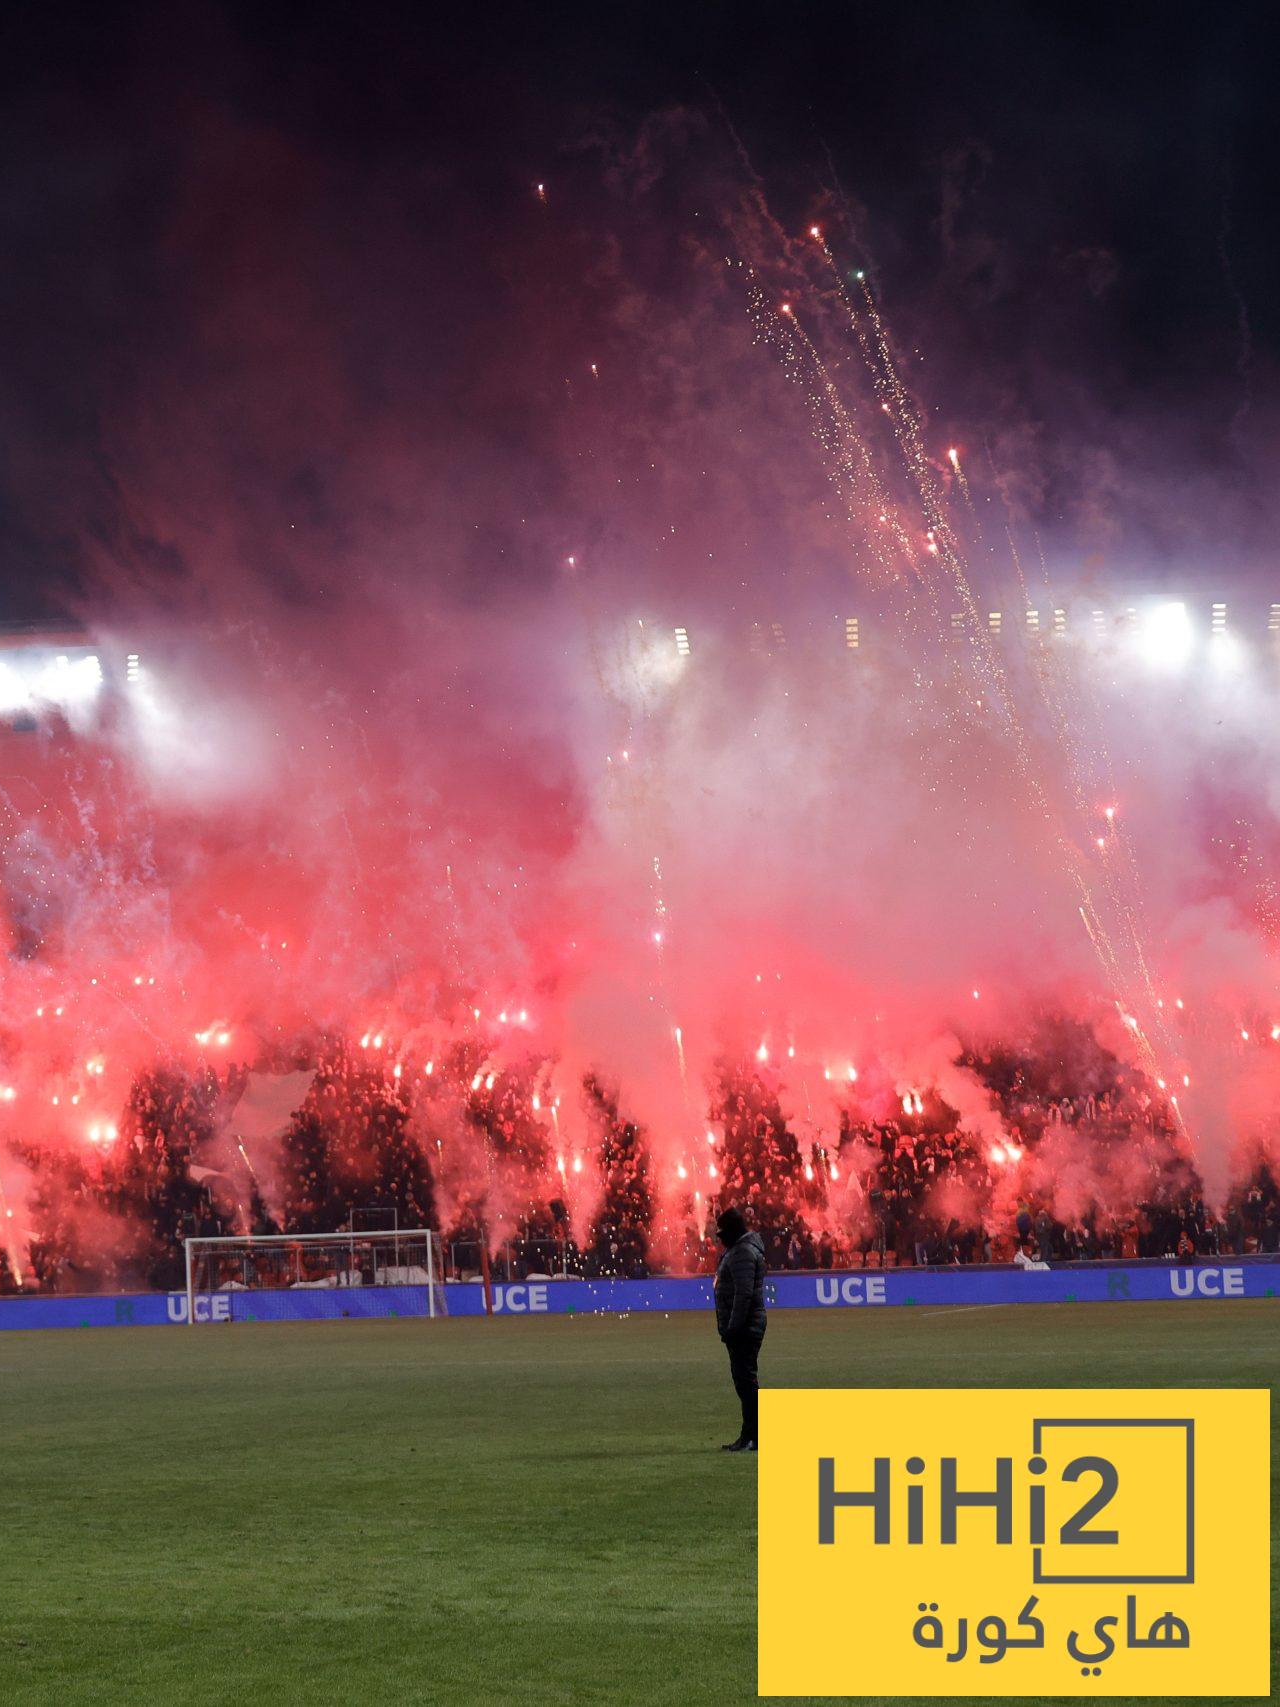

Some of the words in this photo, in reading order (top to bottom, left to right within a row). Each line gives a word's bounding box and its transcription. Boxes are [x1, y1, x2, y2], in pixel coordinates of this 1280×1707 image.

[816, 1277, 886, 1304] UCE
[1170, 1268, 1245, 1297] UCE
[167, 1295, 231, 1322] UCE
